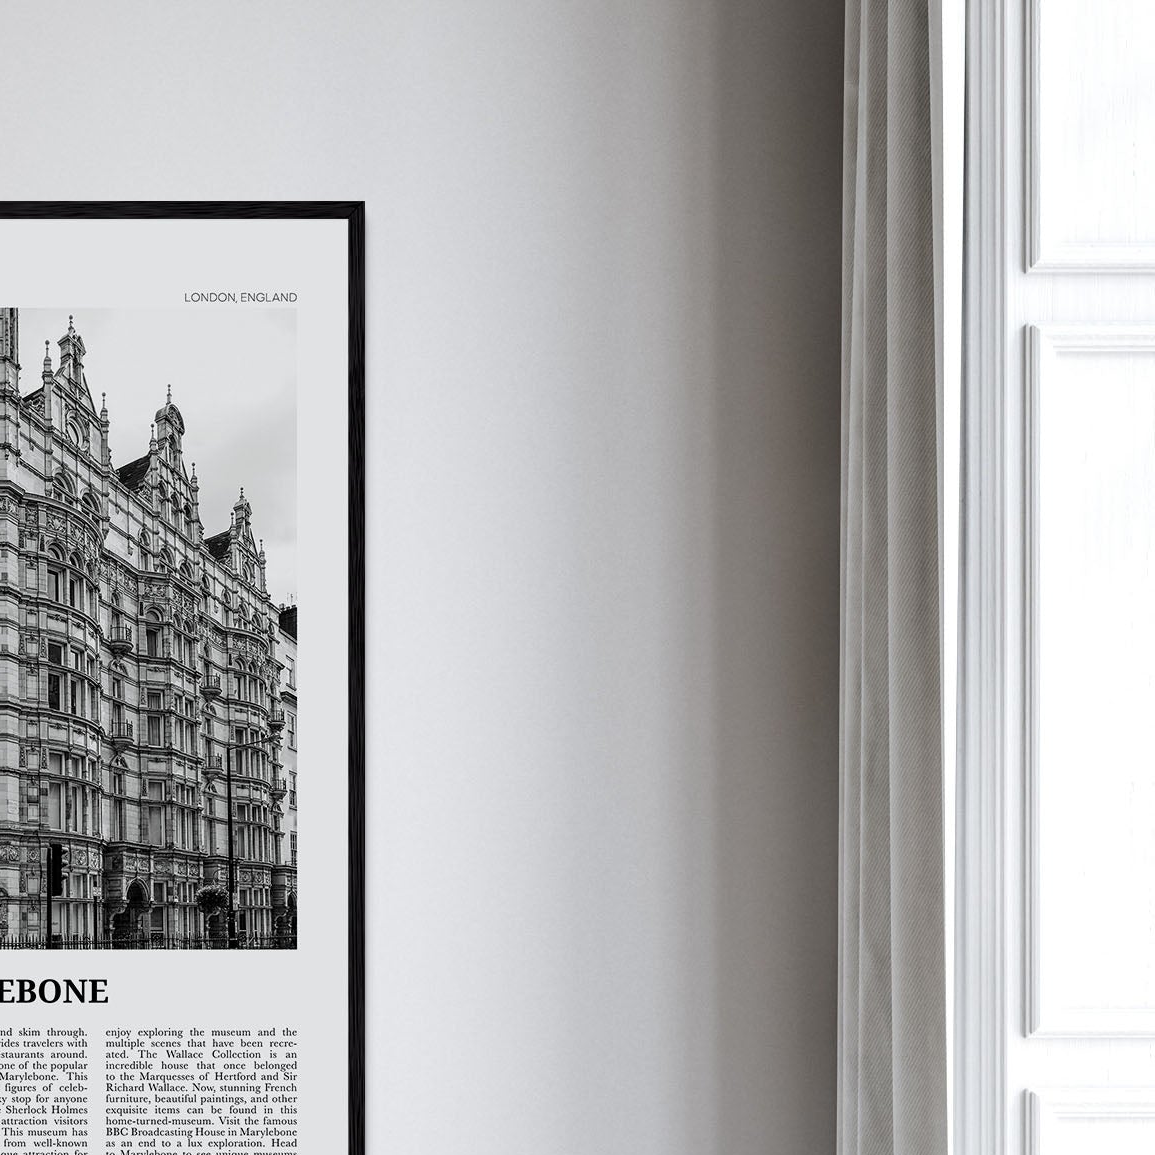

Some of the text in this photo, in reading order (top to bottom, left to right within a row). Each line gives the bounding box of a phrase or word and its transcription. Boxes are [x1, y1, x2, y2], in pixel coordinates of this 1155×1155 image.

[184, 291, 298, 303] LONDON, ENGLAND
[23, 1038, 63, 1048] travelers
[67, 1038, 87, 1048] with
[106, 1038, 145, 1050] multiple
[188, 1038, 205, 1048] that
[213, 1038, 234, 1048] have
[241, 1038, 263, 1048] been
[106, 1061, 153, 1070] incredible
[162, 1061, 188, 1070] house
[197, 1061, 215, 1070] that
[254, 1061, 297, 1072] belonged
[0, 1072, 58, 1084] Marylebone.
[66, 1072, 88, 1081] This
[106, 1083, 297, 1095] Richard Wallace. Now, stunning French
[11, 1094, 31, 1106] stop
[36, 1094, 49, 1103] for
[54, 1097, 87, 1106] anyone
[106, 1094, 297, 1106] furniture, beautiful paintings, and other
[6, 1105, 47, 1114] Sherlock
[52, 1105, 88, 1114] Holmes
[106, 1105, 147, 1117] exquisite
[155, 1105, 180, 1114] items
[211, 1105, 222, 1114] be
[230, 1105, 256, 1114] found
[264, 1105, 273, 1114] in
[281, 1105, 297, 1114] this
[1, 1116, 47, 1126] attraction
[54, 1116, 88, 1126] visitors
[106, 1116, 297, 1126] home-turned-museum. Visit the famous
[1, 1127, 23, 1137] This
[72, 1127, 88, 1137] has
[4, 1138, 26, 1148] from
[34, 1138, 87, 1148] well-known
